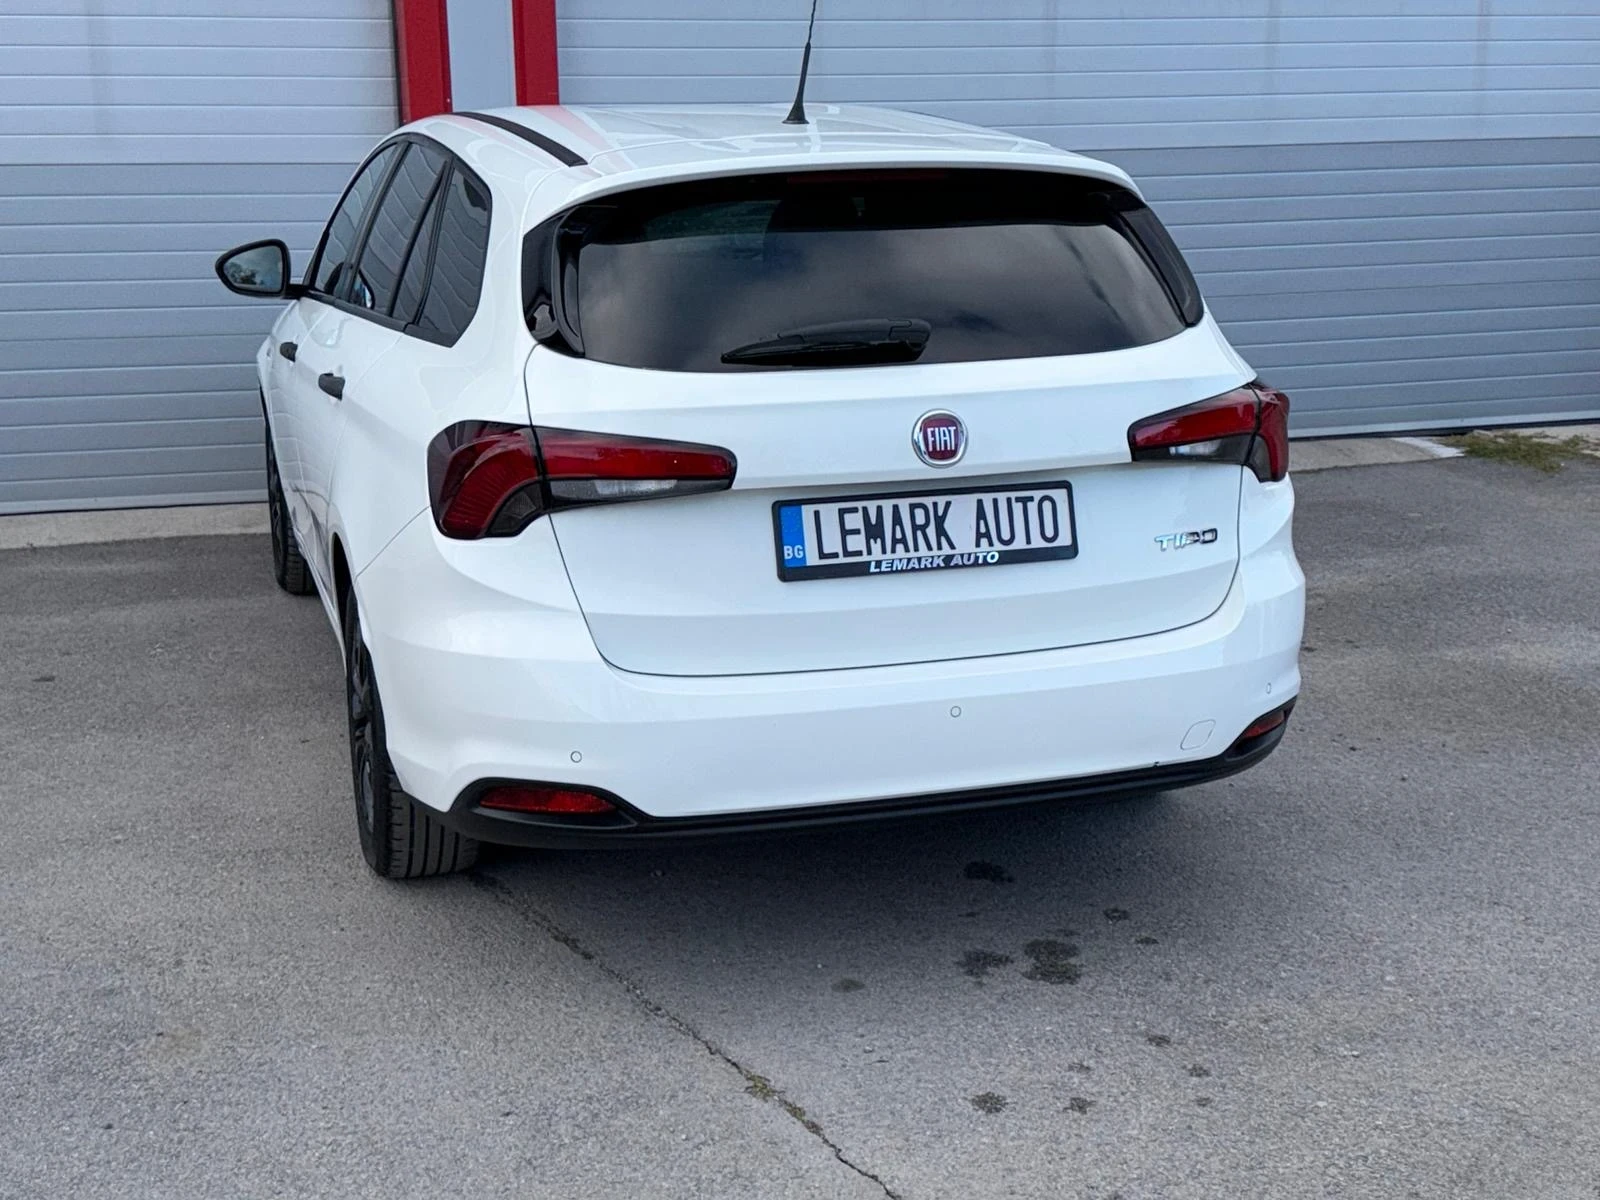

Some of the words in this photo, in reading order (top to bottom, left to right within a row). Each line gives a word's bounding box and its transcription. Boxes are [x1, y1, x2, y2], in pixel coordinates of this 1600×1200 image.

[927, 426, 956, 451] FIAT
[813, 500, 956, 560] LEMARK
[975, 494, 1060, 549] AUTO
[1154, 527, 1218, 552] TIPO
[783, 545, 804, 560] BG
[870, 556, 944, 573] LEMARK
[950, 551, 1000, 566] AUTO
